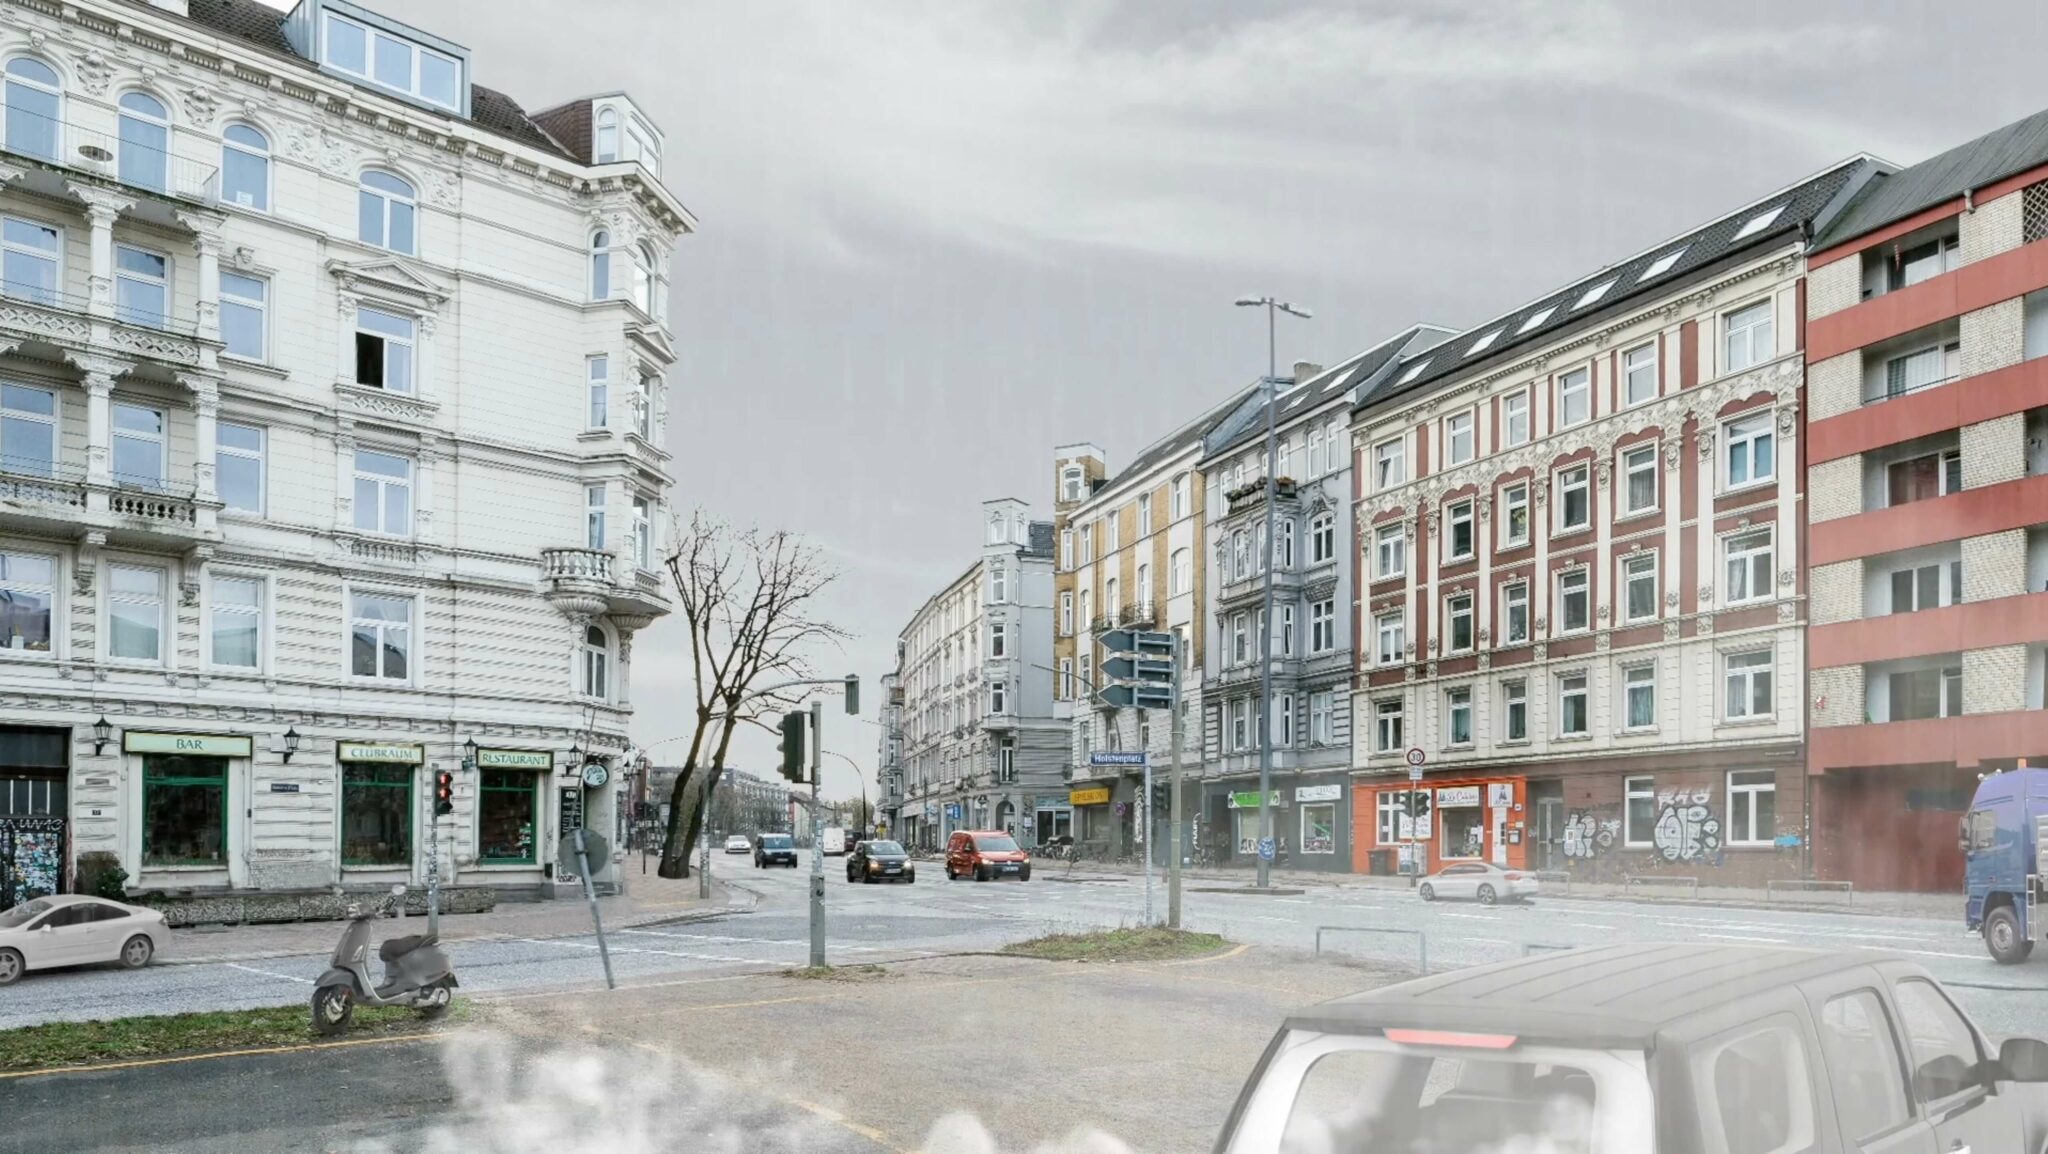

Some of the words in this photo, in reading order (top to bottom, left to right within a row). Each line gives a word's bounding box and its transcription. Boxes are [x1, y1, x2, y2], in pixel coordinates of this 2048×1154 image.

[176, 738, 204, 750] BAR
[1094, 754, 1143, 765] Holstenplatz
[1410, 752, 1421, 761] 30
